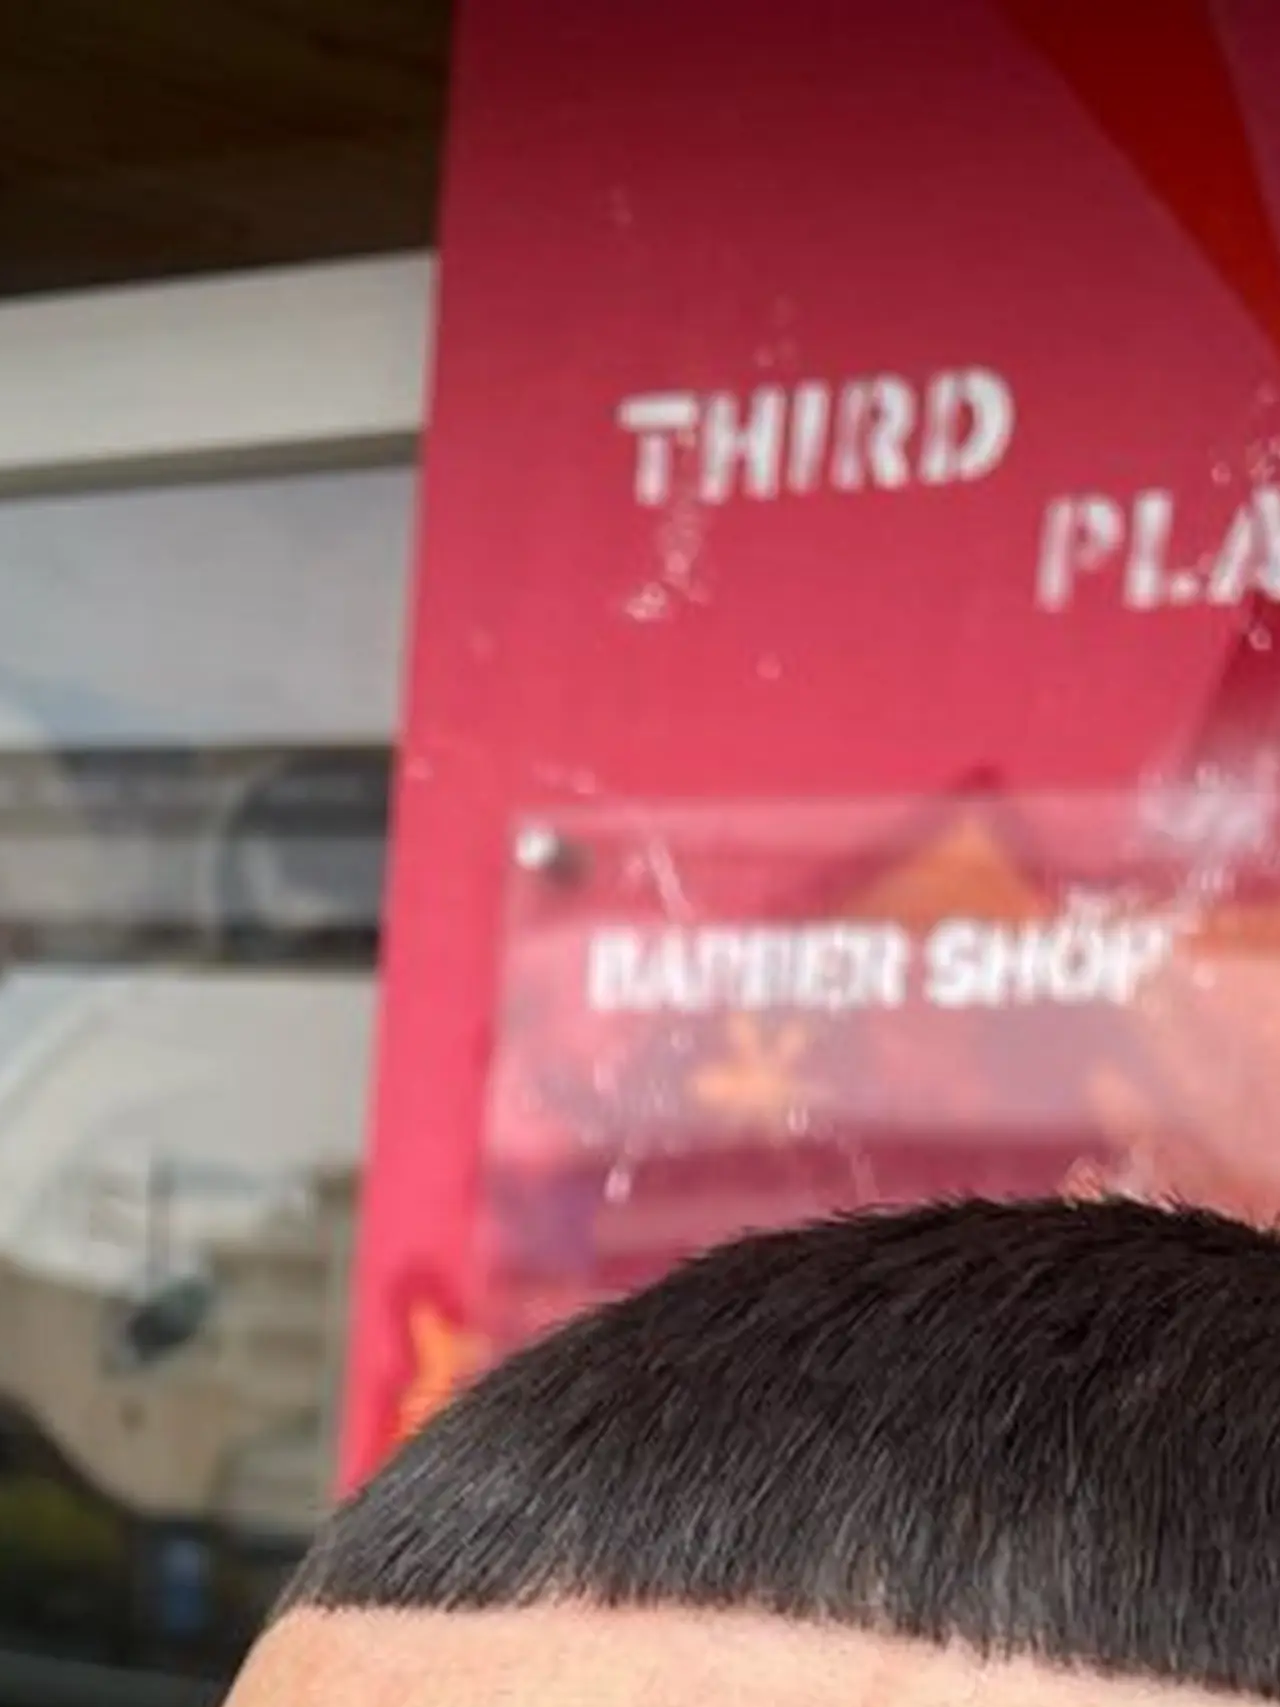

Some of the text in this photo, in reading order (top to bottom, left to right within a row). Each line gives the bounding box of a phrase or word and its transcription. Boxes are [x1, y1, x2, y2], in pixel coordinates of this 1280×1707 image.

[617, 368, 1016, 505] THIRD
[589, 915, 1171, 1011] BARBER SHOP
